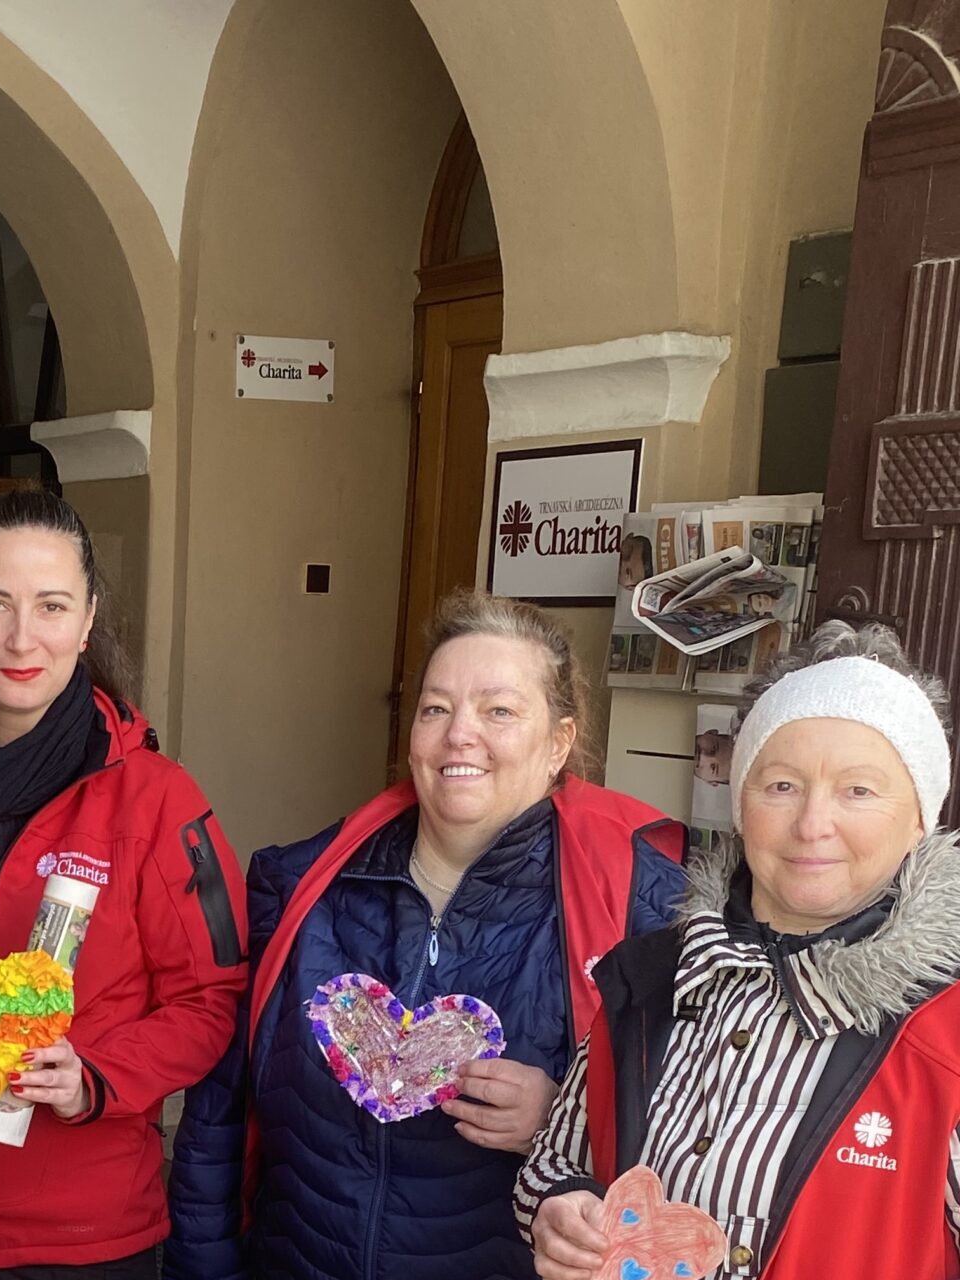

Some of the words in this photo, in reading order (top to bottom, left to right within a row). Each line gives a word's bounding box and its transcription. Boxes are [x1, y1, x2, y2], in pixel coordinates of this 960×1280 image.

[258, 363, 302, 379] Charita
[534, 515, 622, 555] Charita
[57, 858, 109, 884] Charita
[836, 1146, 897, 1171] Charita
